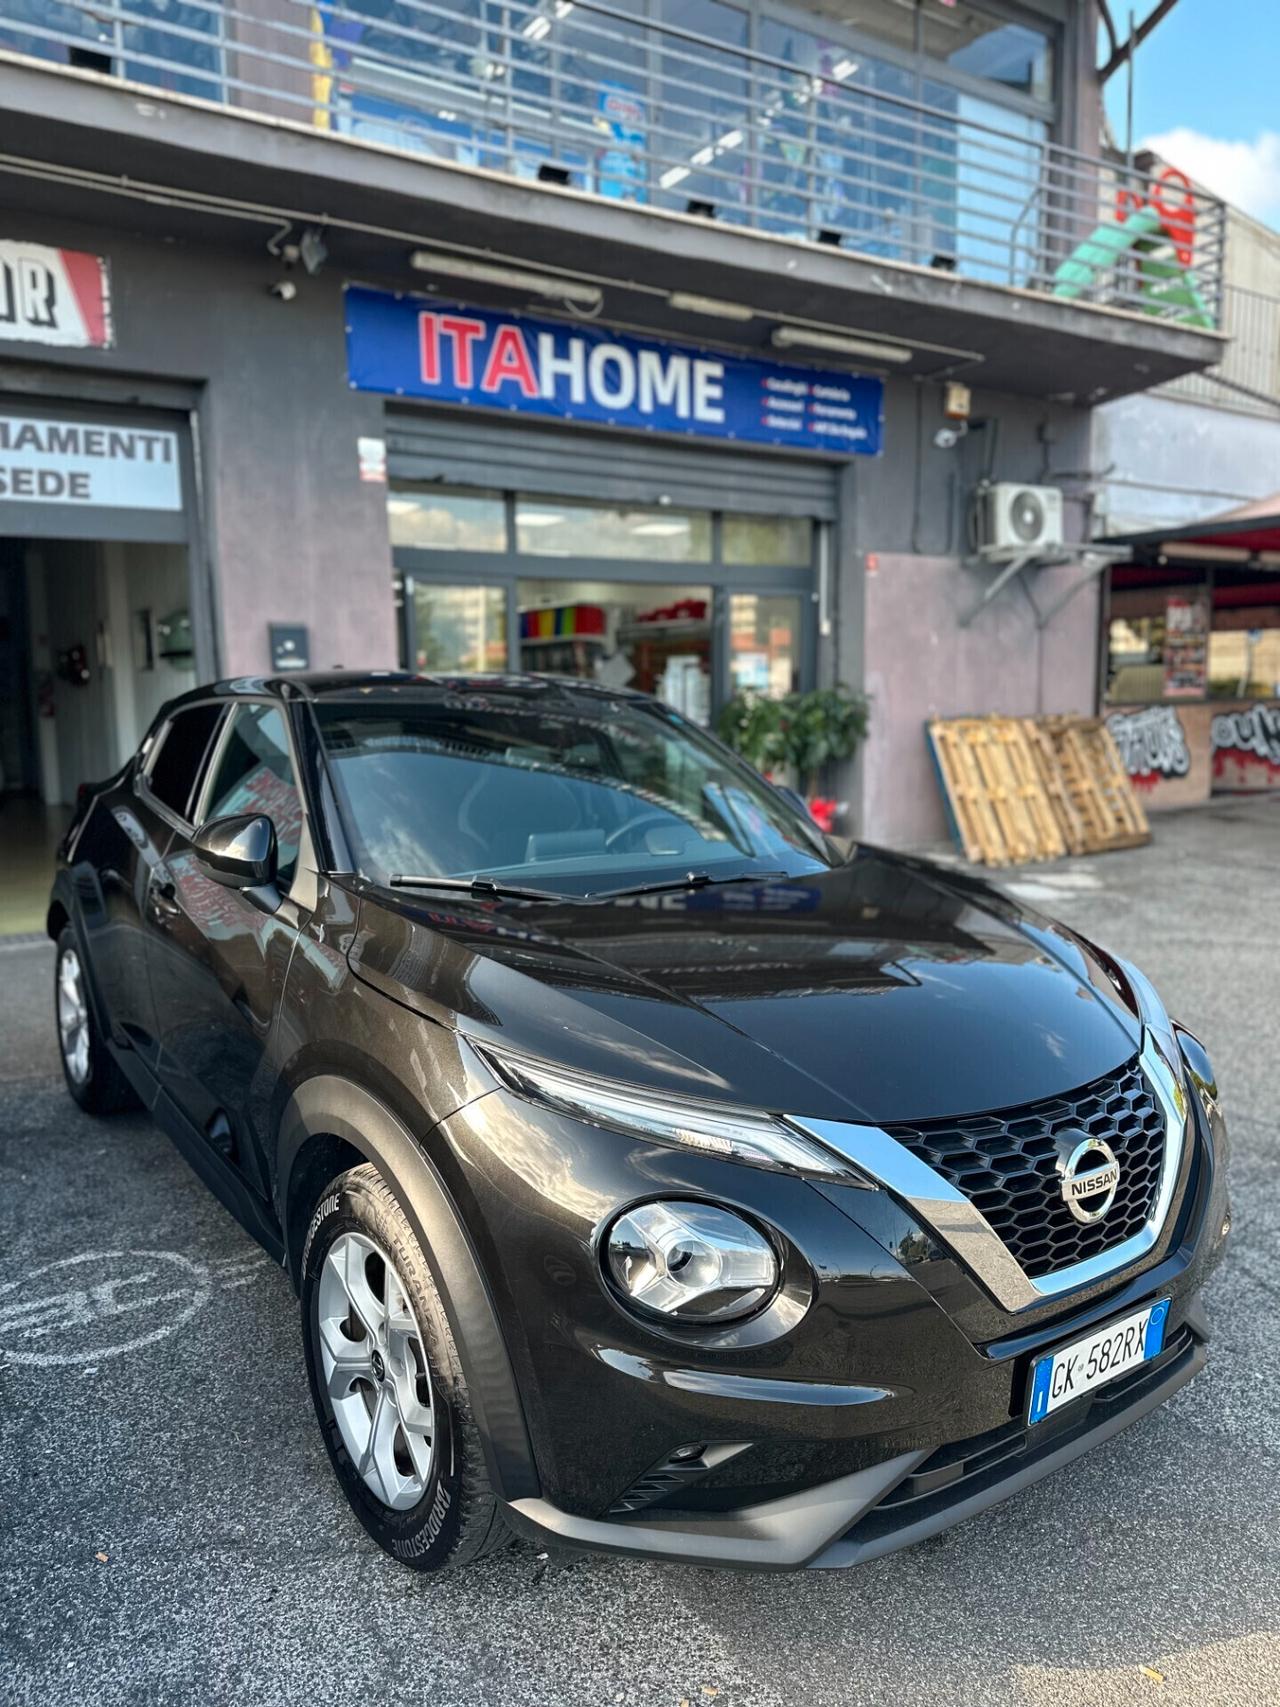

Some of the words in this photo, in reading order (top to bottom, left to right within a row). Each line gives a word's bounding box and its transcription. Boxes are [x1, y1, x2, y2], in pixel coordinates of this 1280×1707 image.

[418, 311, 726, 424] ITAHOME
[1071, 1168, 1118, 1197] NISSAN
[1051, 1354, 1079, 1399] GK
[1086, 1317, 1149, 1380] 582RX
[391, 1479, 452, 1558] BRIDGESTONE
